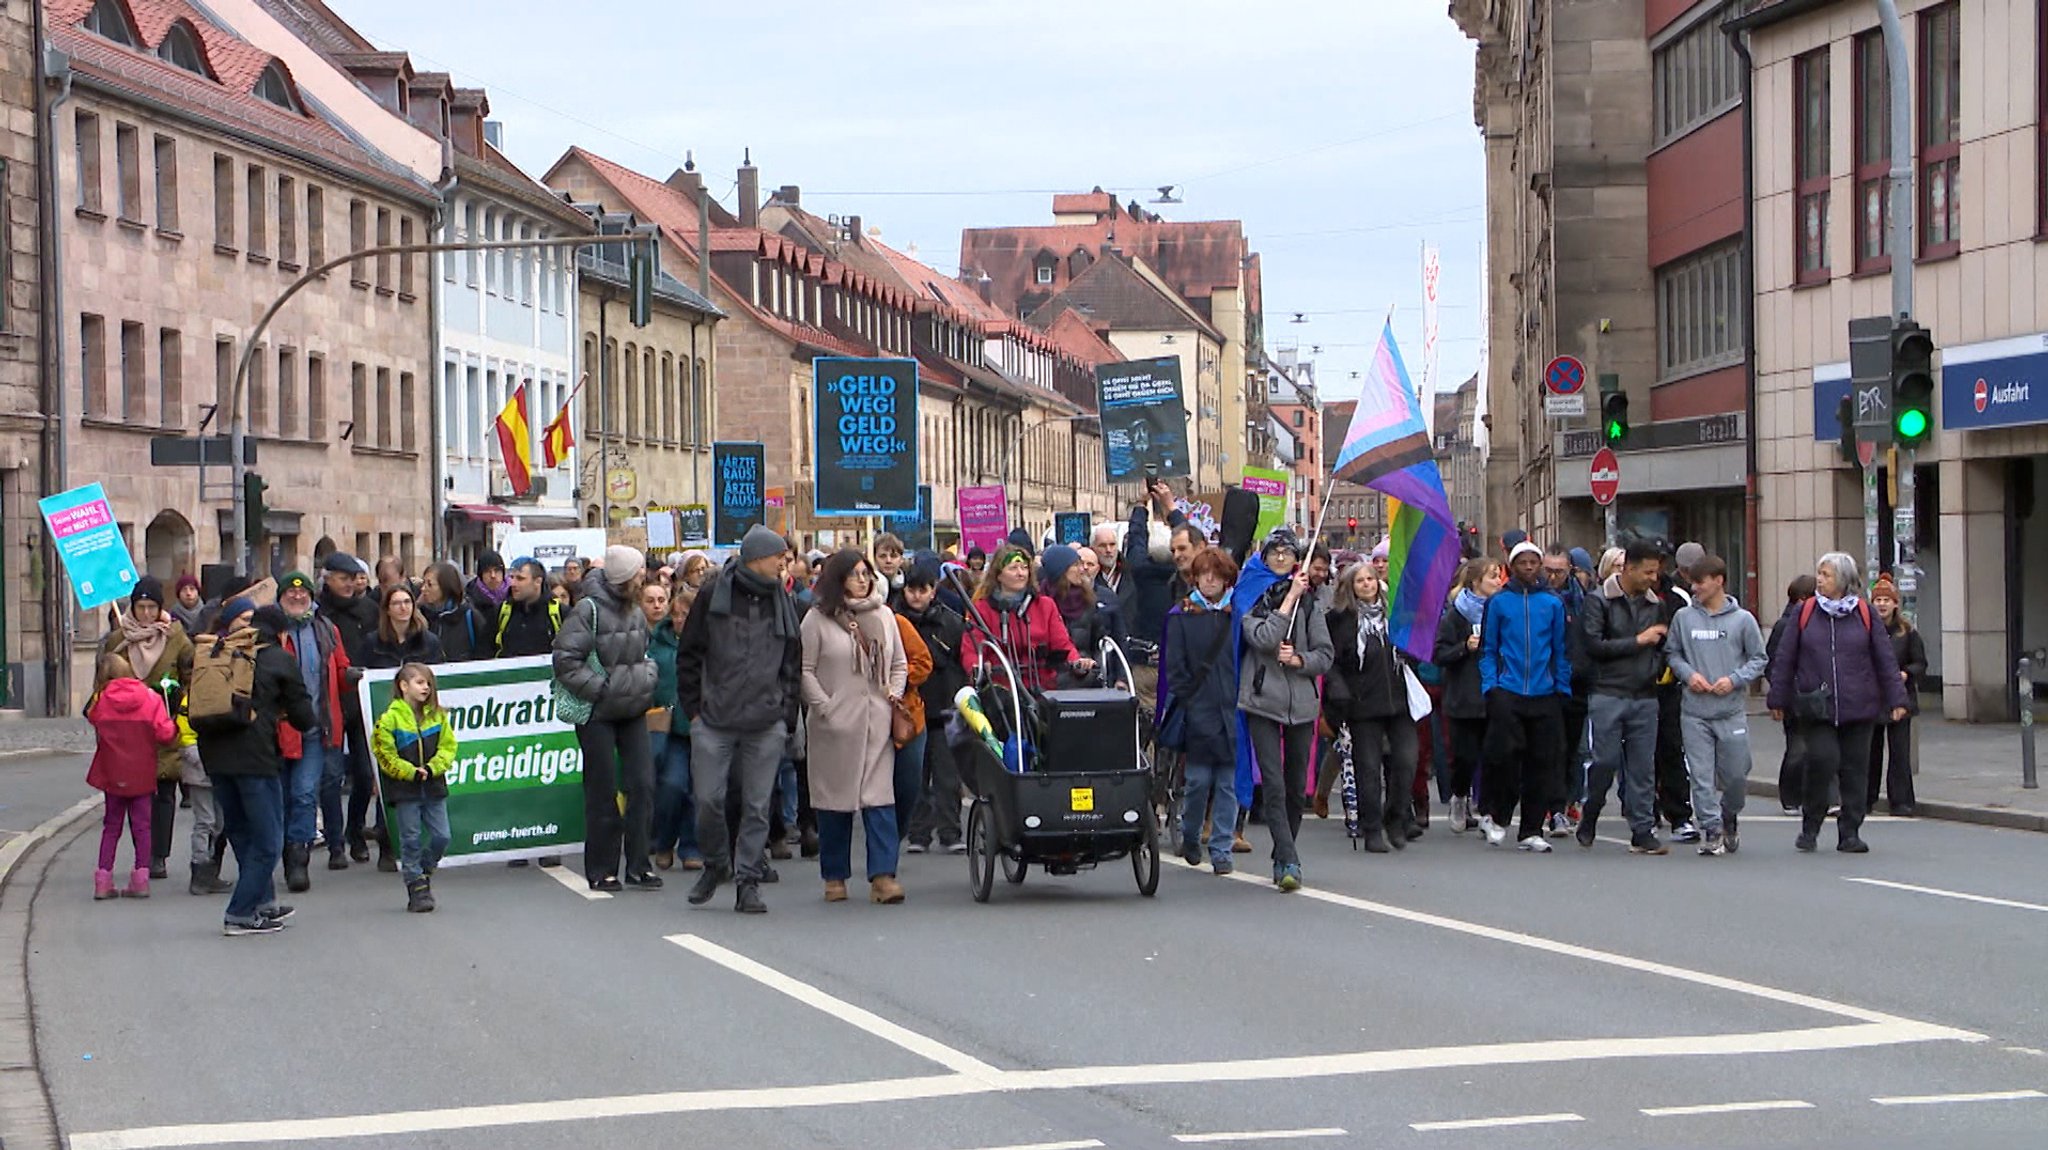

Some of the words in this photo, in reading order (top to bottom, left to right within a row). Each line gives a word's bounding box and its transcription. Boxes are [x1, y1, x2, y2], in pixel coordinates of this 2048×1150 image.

[1991, 380, 2030, 404] Ausfahrt
[841, 396, 895, 413] WEG!
[839, 415, 896, 435] GELD
[449, 691, 555, 731] mokrati
[445, 743, 583, 786] erteidige
[472, 823, 558, 845] gruene-fuerth.de
